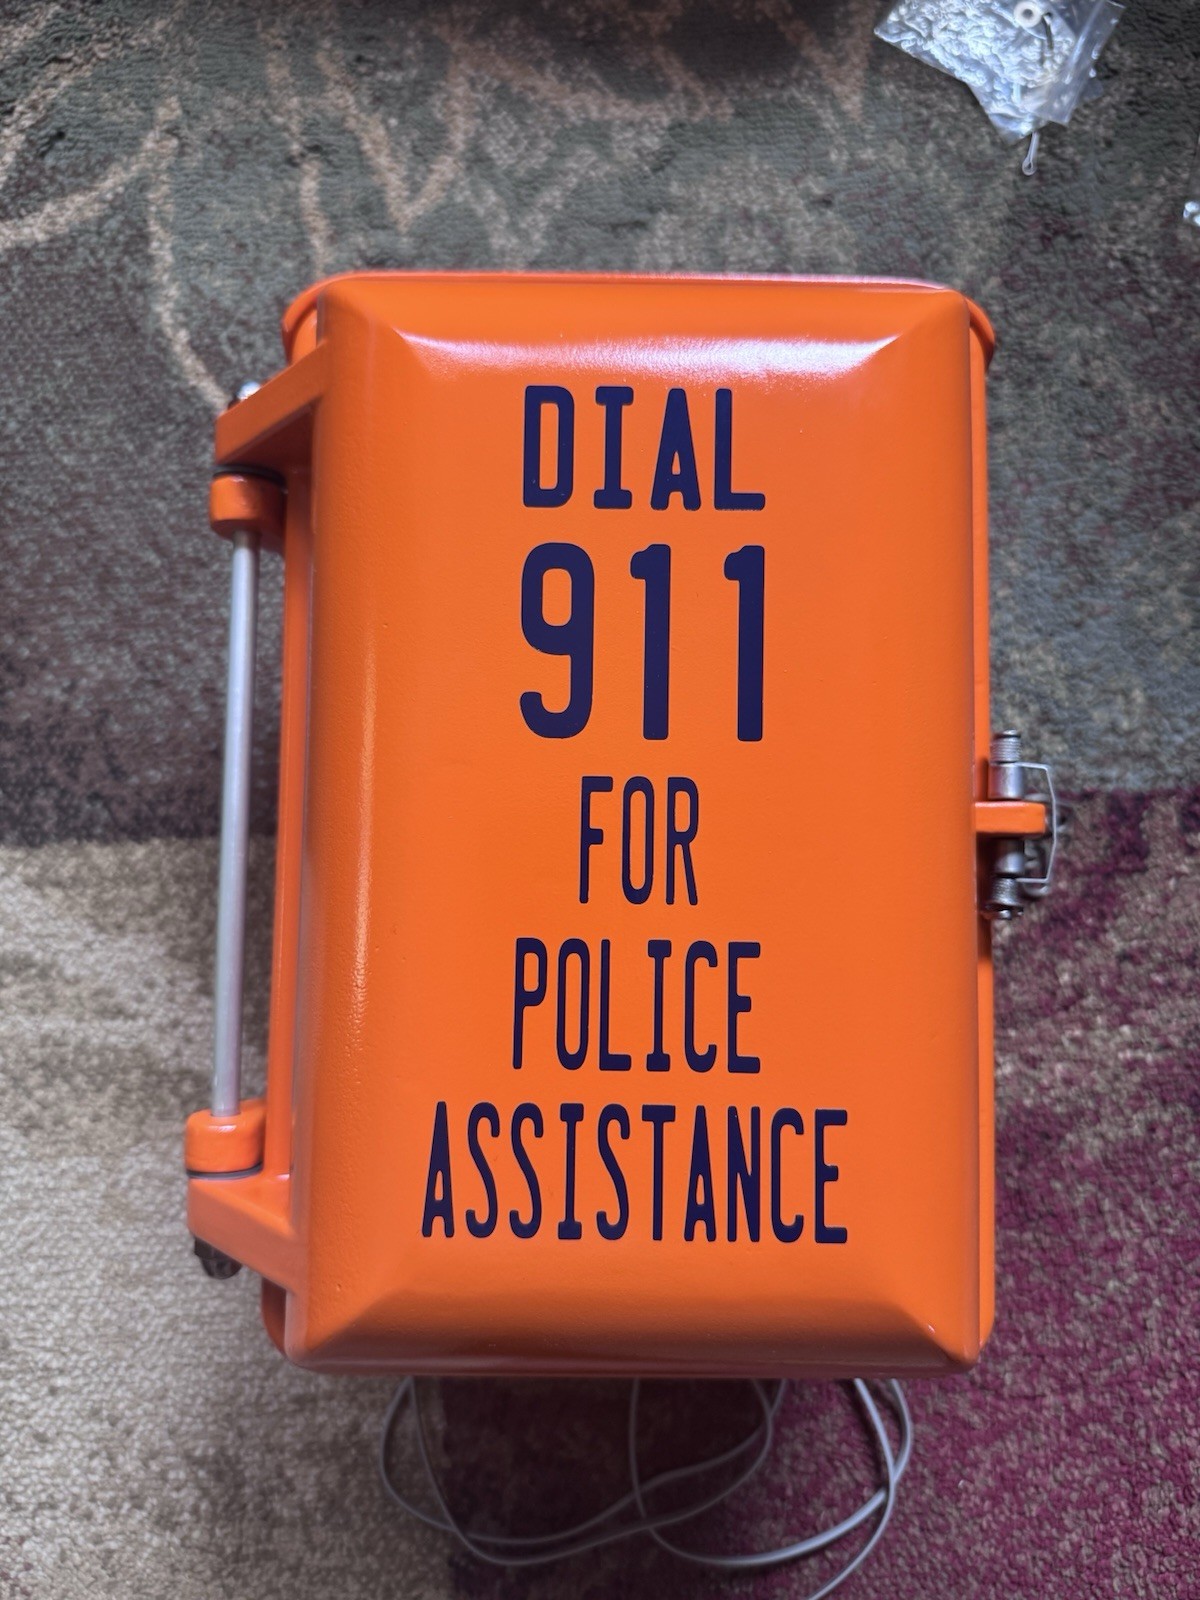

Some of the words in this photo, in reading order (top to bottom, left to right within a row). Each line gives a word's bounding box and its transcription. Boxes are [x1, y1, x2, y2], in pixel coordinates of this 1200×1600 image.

[523, 385, 765, 510] DIAL
[520, 542, 764, 741] 911
[579, 776, 699, 905] FOR
[513, 937, 761, 1073] POLICE
[422, 1101, 848, 1243] ASSISTANCE
